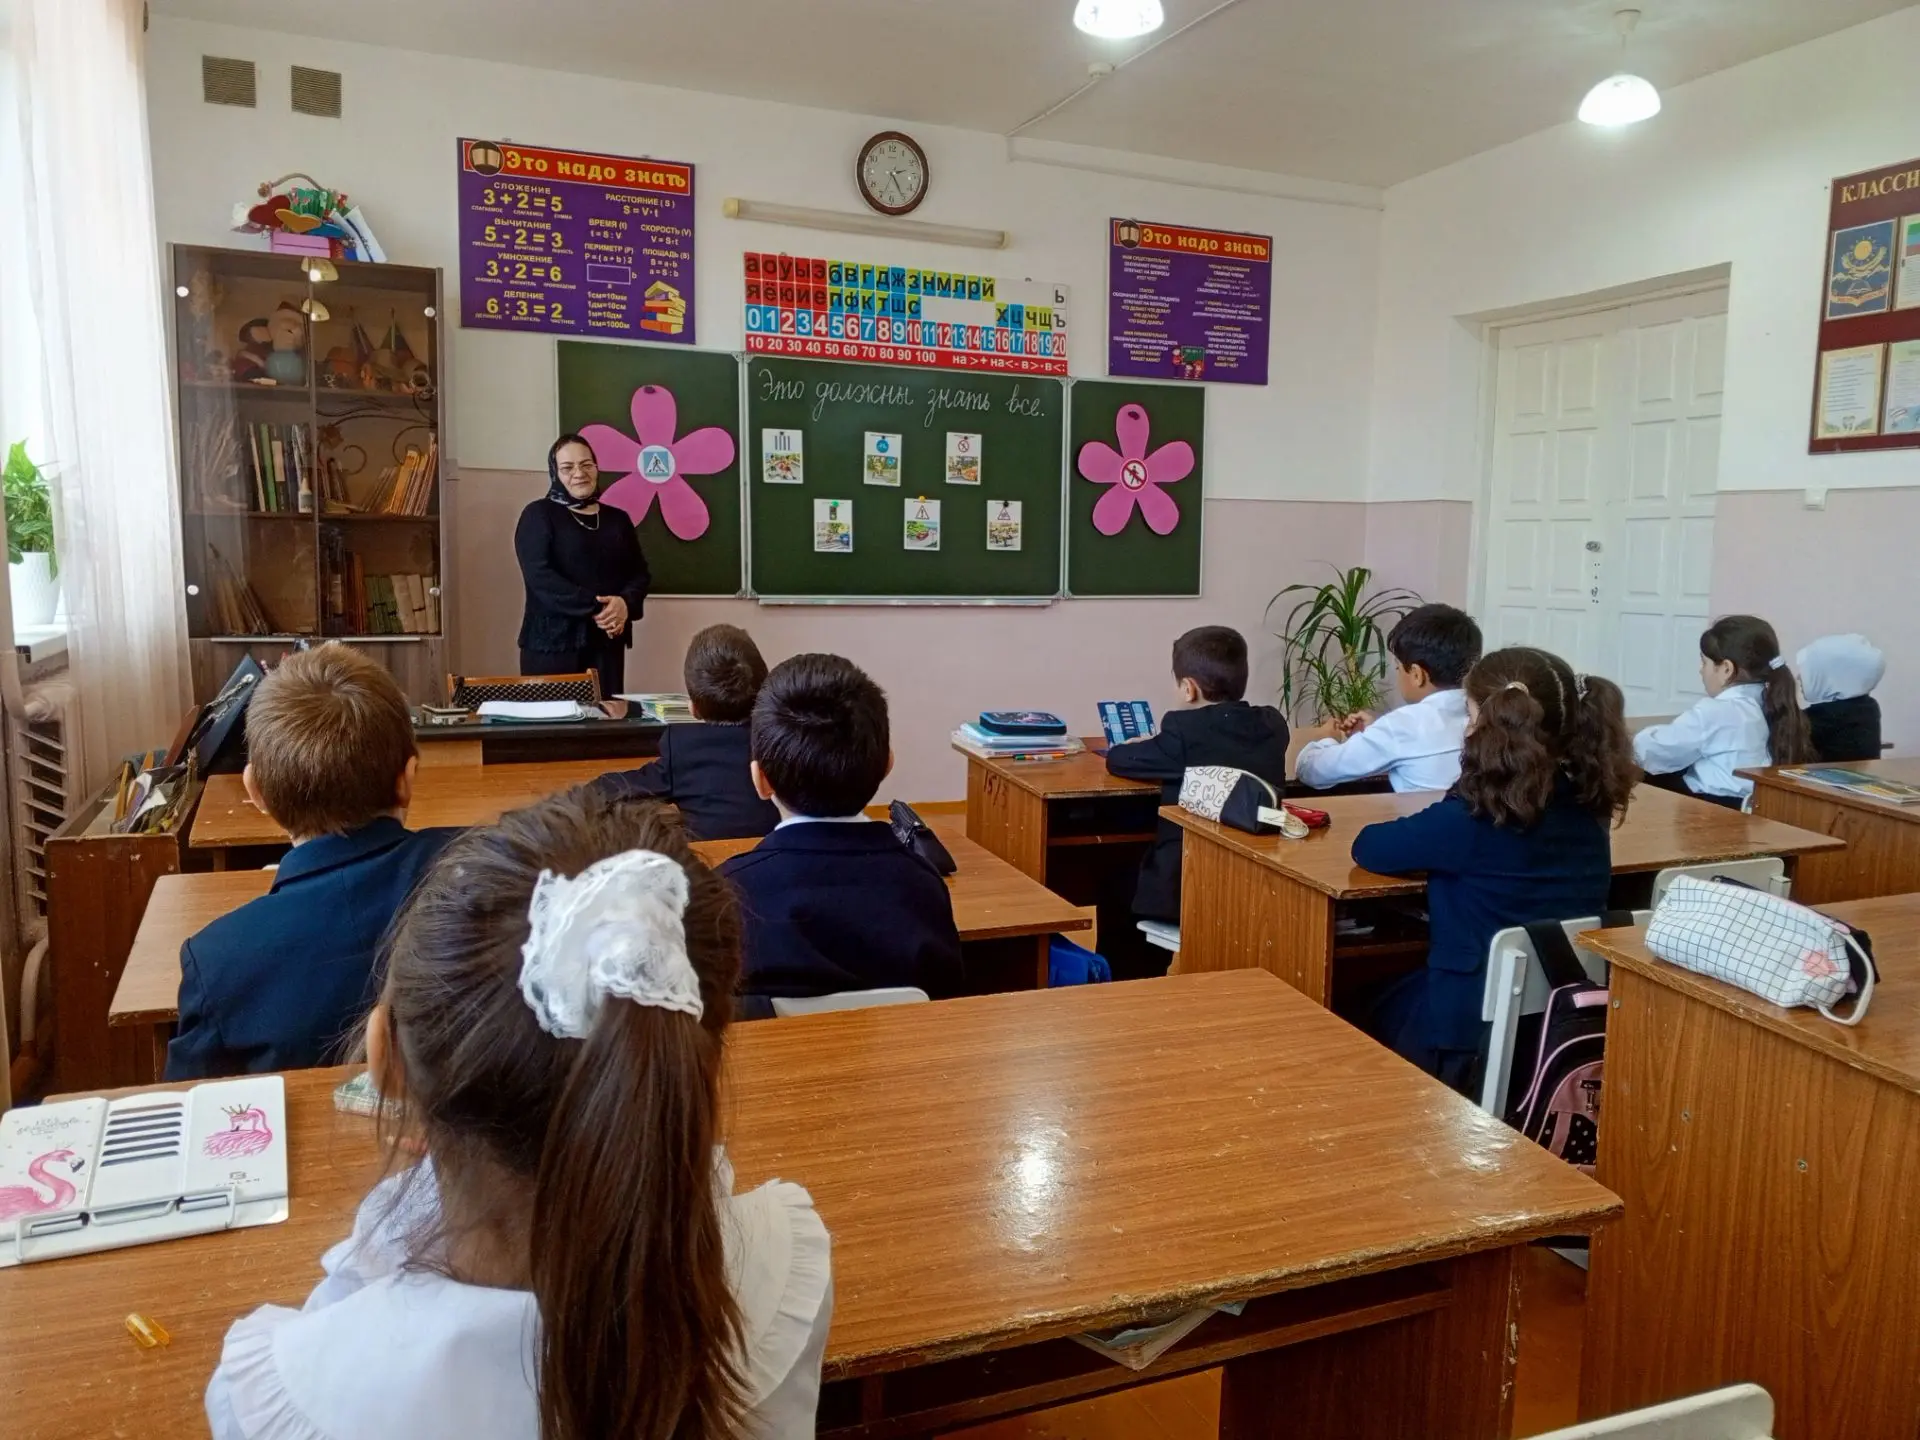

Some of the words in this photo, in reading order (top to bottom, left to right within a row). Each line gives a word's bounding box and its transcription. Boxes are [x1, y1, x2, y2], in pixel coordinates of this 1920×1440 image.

[506, 150, 548, 172] Это
[557, 161, 616, 181] надо
[625, 169, 686, 188] знать
[493, 182, 551, 195] СЛОЖЕНИЕ
[483, 189, 495, 205] 3
[500, 193, 512, 205] +
[517, 193, 529, 208] 2
[533, 197, 546, 208] =
[551, 196, 562, 212] 5
[605, 193, 659, 206] РАССТОЯНИЕ
[494, 218, 552, 230] ВЫЧИТАНИЕ
[589, 218, 617, 228] ВРЕМЯ
[640, 224, 680, 235] СКОРОСТЬ
[484, 225, 497, 242] 5
[515, 228, 527, 245] 2
[533, 233, 545, 243] =
[551, 231, 563, 248] 3
[1143, 228, 1172, 244] Это
[1178, 236, 1218, 251] надо
[1224, 241, 1266, 256] знать
[584, 243, 623, 252] ПЕРИМЕТР
[643, 248, 679, 258] ПЛОЩАДЬ
[497, 252, 553, 264] УМНОЖЕНИЕ
[503, 290, 545, 300] ДЕЛЕНИЕ
[748, 308, 761, 329] 0
[766, 310, 776, 330] 1
[781, 311, 795, 332] 2
[798, 313, 811, 333] 3
[814, 314, 827, 335] 4
[831, 316, 844, 336] 5
[847, 317, 859, 338] 6
[862, 319, 874, 339] 7
[877, 320, 890, 340] 8
[893, 322, 905, 342] 9
[907, 323, 921, 343] 10
[923, 324, 936, 345] 11
[938, 326, 951, 347] 12
[952, 328, 966, 348] 13
[967, 329, 980, 348] 14
[982, 330, 995, 350] 15
[996, 331, 1009, 351] 16
[1010, 332, 1023, 352] 17
[1025, 333, 1038, 353] 18
[1040, 335, 1052, 355] 19
[1053, 336, 1066, 355] 20
[748, 337, 763, 349] 10
[767, 338, 783, 350] 20
[787, 339, 802, 351] 30
[806, 341, 821, 353] 40
[825, 343, 839, 355] 50
[843, 345, 857, 356] 60
[862, 346, 876, 358] 70
[879, 347, 894, 359] 80
[897, 349, 911, 361] 90
[915, 351, 936, 363] 100
[758, 368, 805, 401] Это
[812, 381, 914, 422] должны
[924, 388, 990, 428] знать
[1005, 383, 1045, 417] все.
